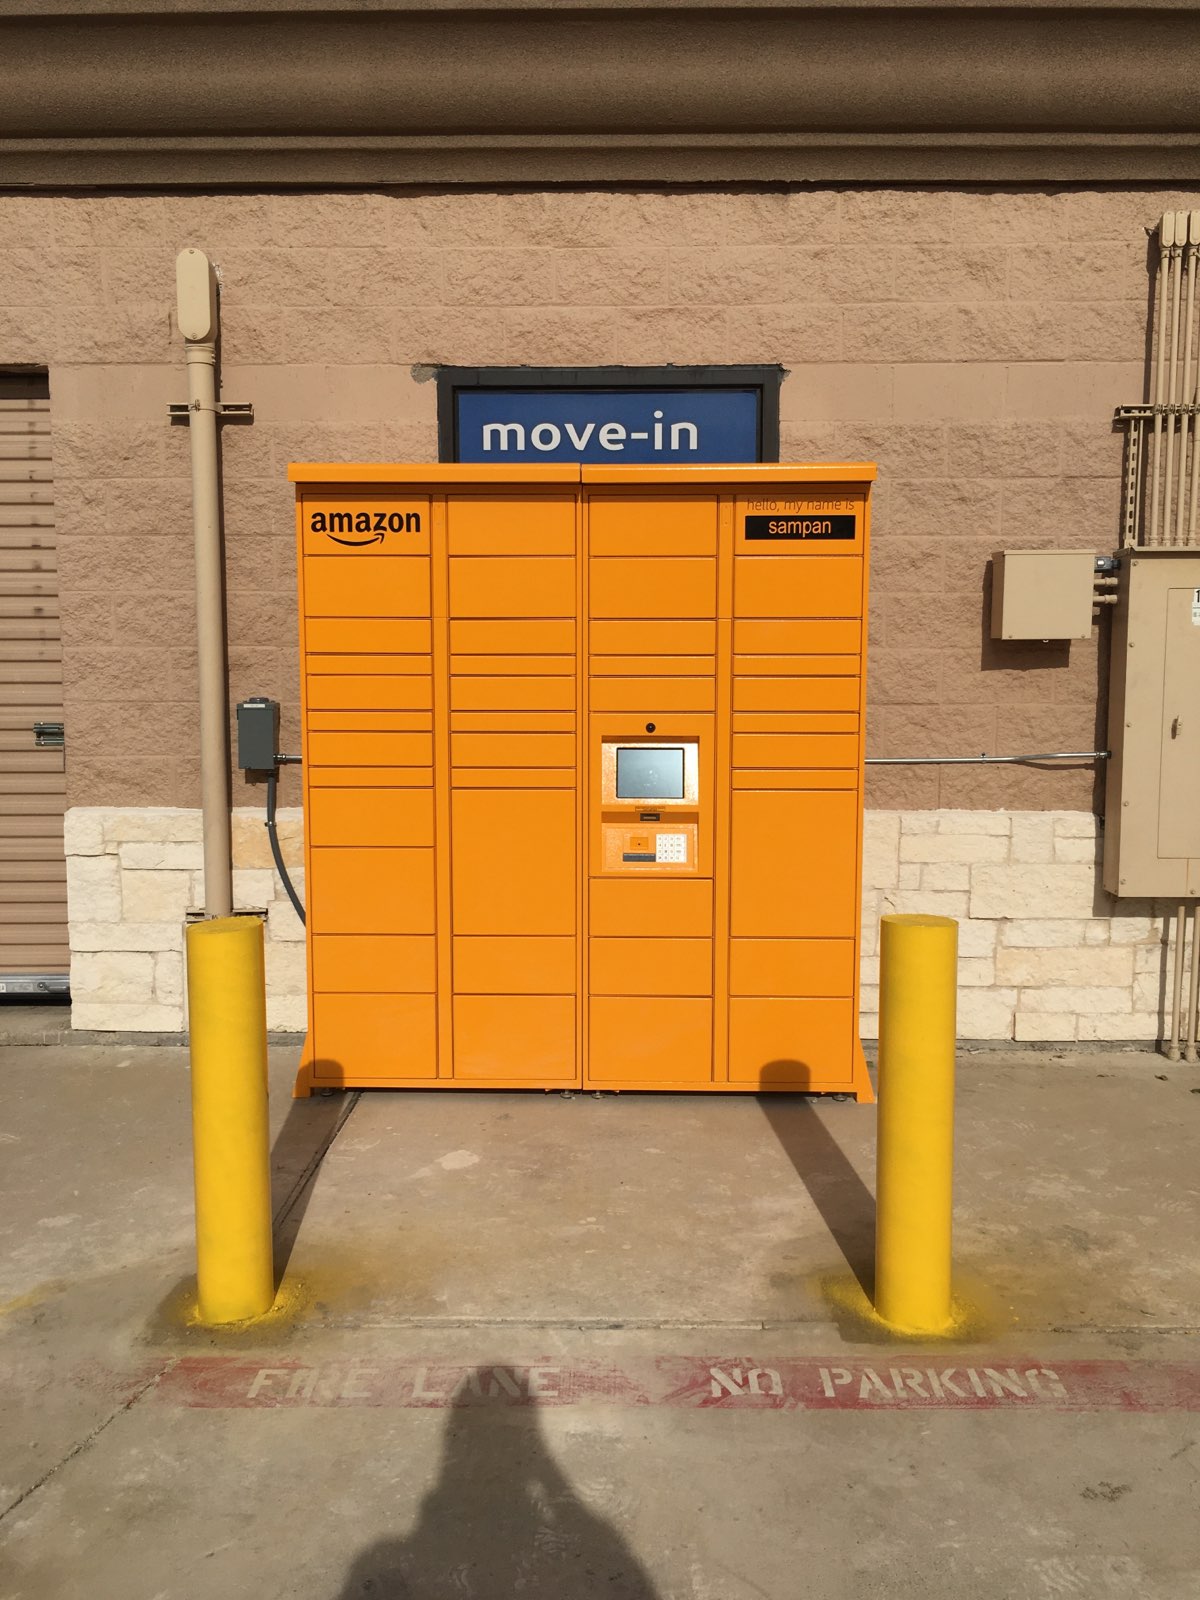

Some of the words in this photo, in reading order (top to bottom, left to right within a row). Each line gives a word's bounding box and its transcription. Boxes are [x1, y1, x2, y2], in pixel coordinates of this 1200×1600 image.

[482, 410, 698, 451] move-in
[747, 498, 780, 512] hello,
[784, 500, 804, 513] my
[806, 500, 842, 511] name
[845, 498, 855, 511] is
[310, 512, 421, 533] amazon
[768, 520, 832, 538] sampan
[411, 1366, 560, 1398] LANE
[710, 1367, 783, 1398] NO
[818, 1366, 1068, 1399] PARKING
